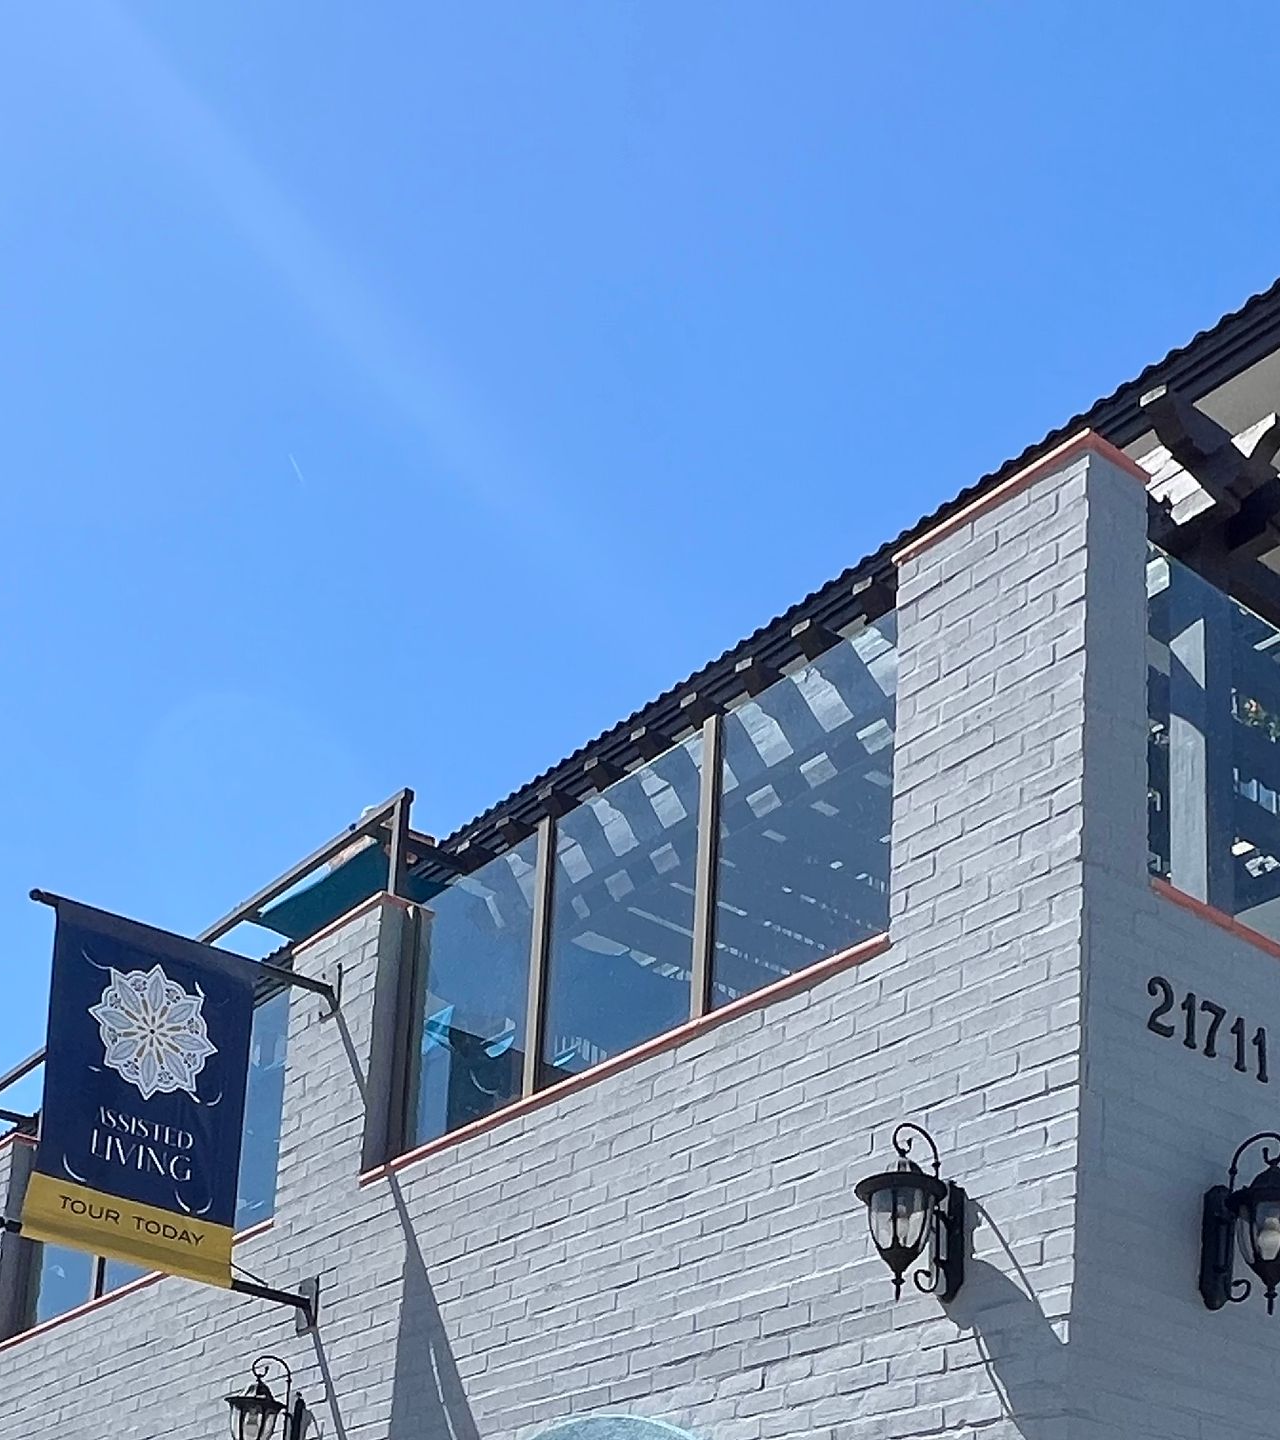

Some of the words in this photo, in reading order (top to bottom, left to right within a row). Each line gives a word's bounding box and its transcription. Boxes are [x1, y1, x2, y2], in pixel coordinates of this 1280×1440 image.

[1146, 975, 1269, 1083] 21711
[90, 1127, 192, 1182] LIVING
[97, 1104, 194, 1151] ASSISTED
[58, 1193, 120, 1225] TOUR
[131, 1215, 205, 1247] TODAY
